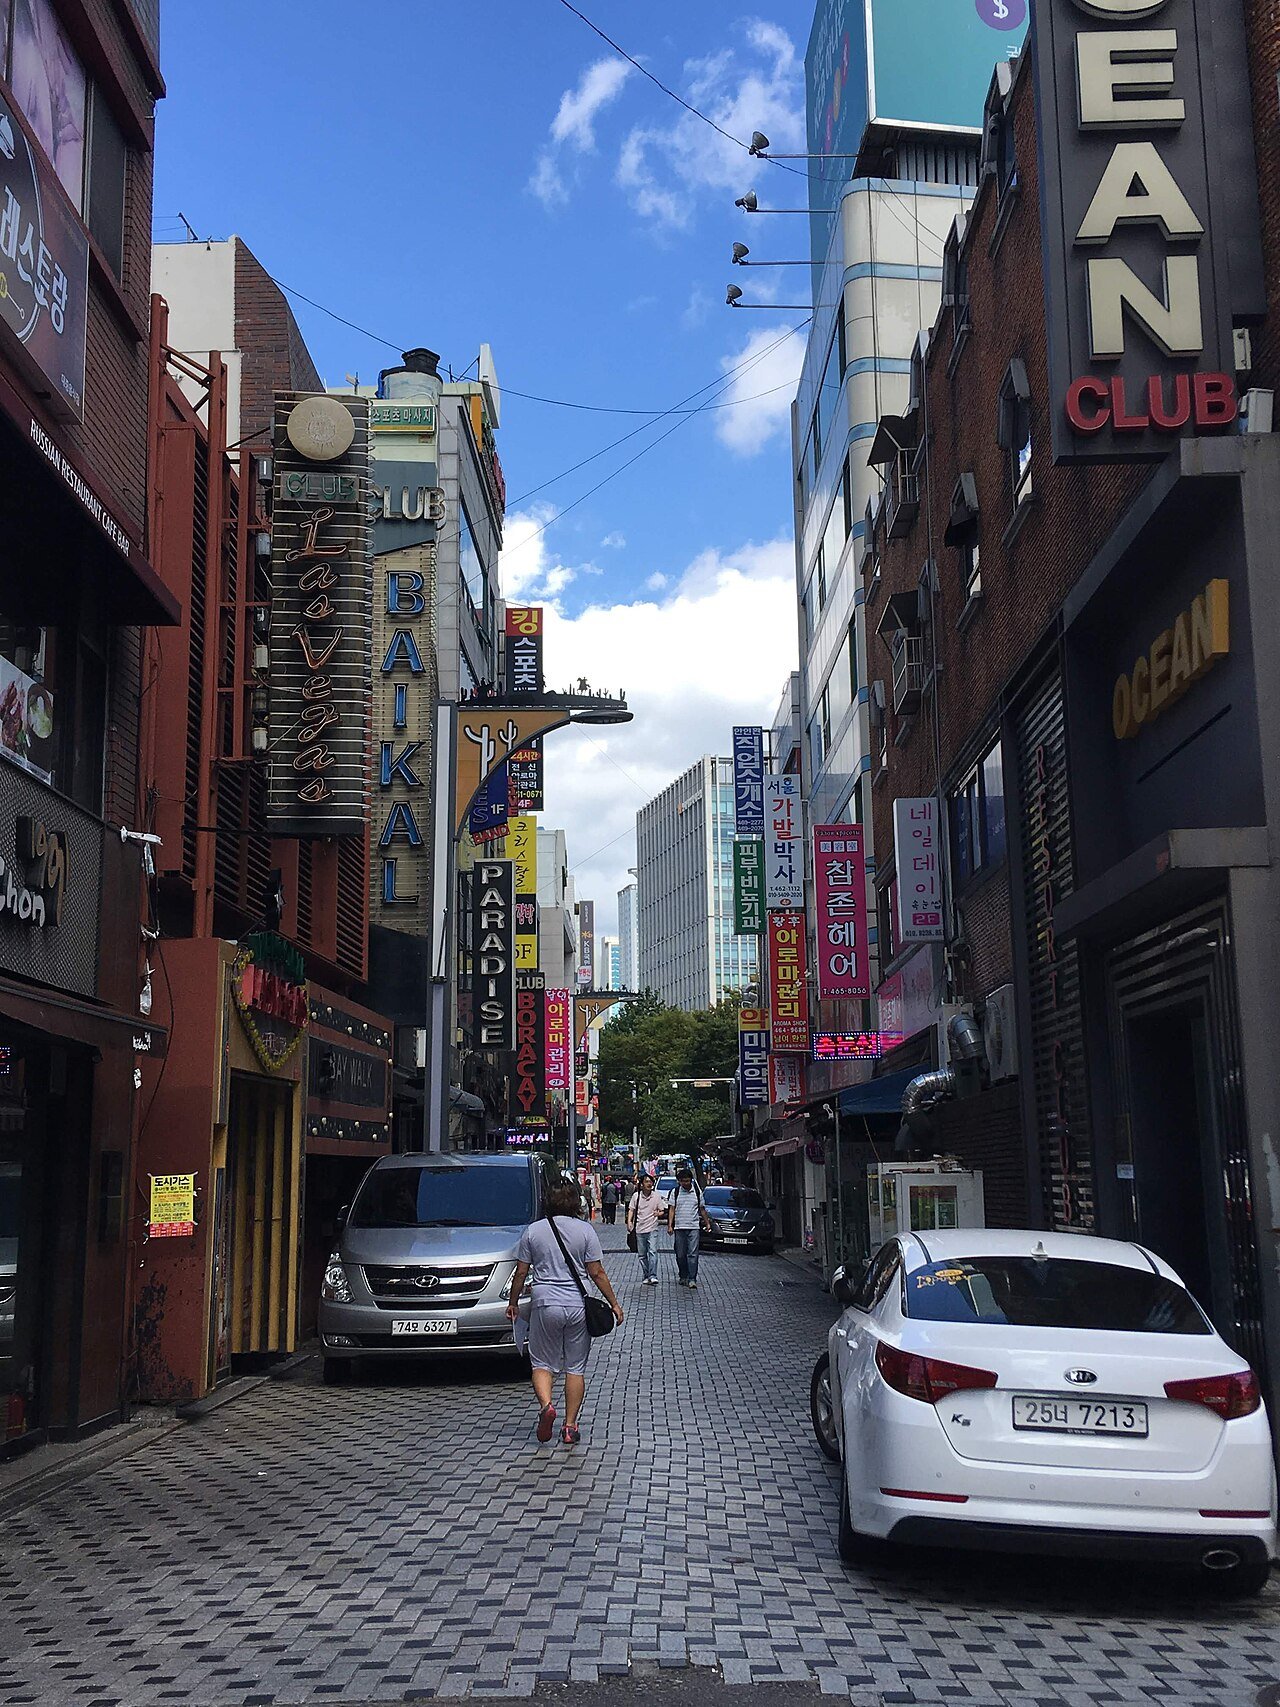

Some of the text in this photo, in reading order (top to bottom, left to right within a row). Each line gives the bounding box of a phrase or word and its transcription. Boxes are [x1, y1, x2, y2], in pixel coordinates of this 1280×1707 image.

[1072, 0, 1205, 361] EAN
[0, 185, 68, 334] 레스토랑
[403, 408, 431, 423] 마사지
[1065, 370, 1238, 437] CLUB
[30, 418, 131, 557] RUSSIAN RESTAURANT CAFE BAR
[285, 473, 356, 500] CLUB
[511, 609, 540, 635] 킹
[1112, 578, 1230, 740] OCEAN
[379, 570, 427, 905] BAIKAL
[490, 804, 505, 815] 1F
[735, 736, 763, 818] 직업소개소
[910, 802, 935, 894] 네일데이
[479, 865, 507, 1044] PARADISE
[775, 929, 800, 1018] 아로마관리
[350, 1057, 373, 1088] WALK
[516, 991, 538, 1112] BORACAY
[154, 1176, 190, 1187] 도시가스
[423, 1320, 452, 1332] 6327
[1070, 1370, 1094, 1382] KIA
[1025, 1401, 1136, 1429] 25너 7213
